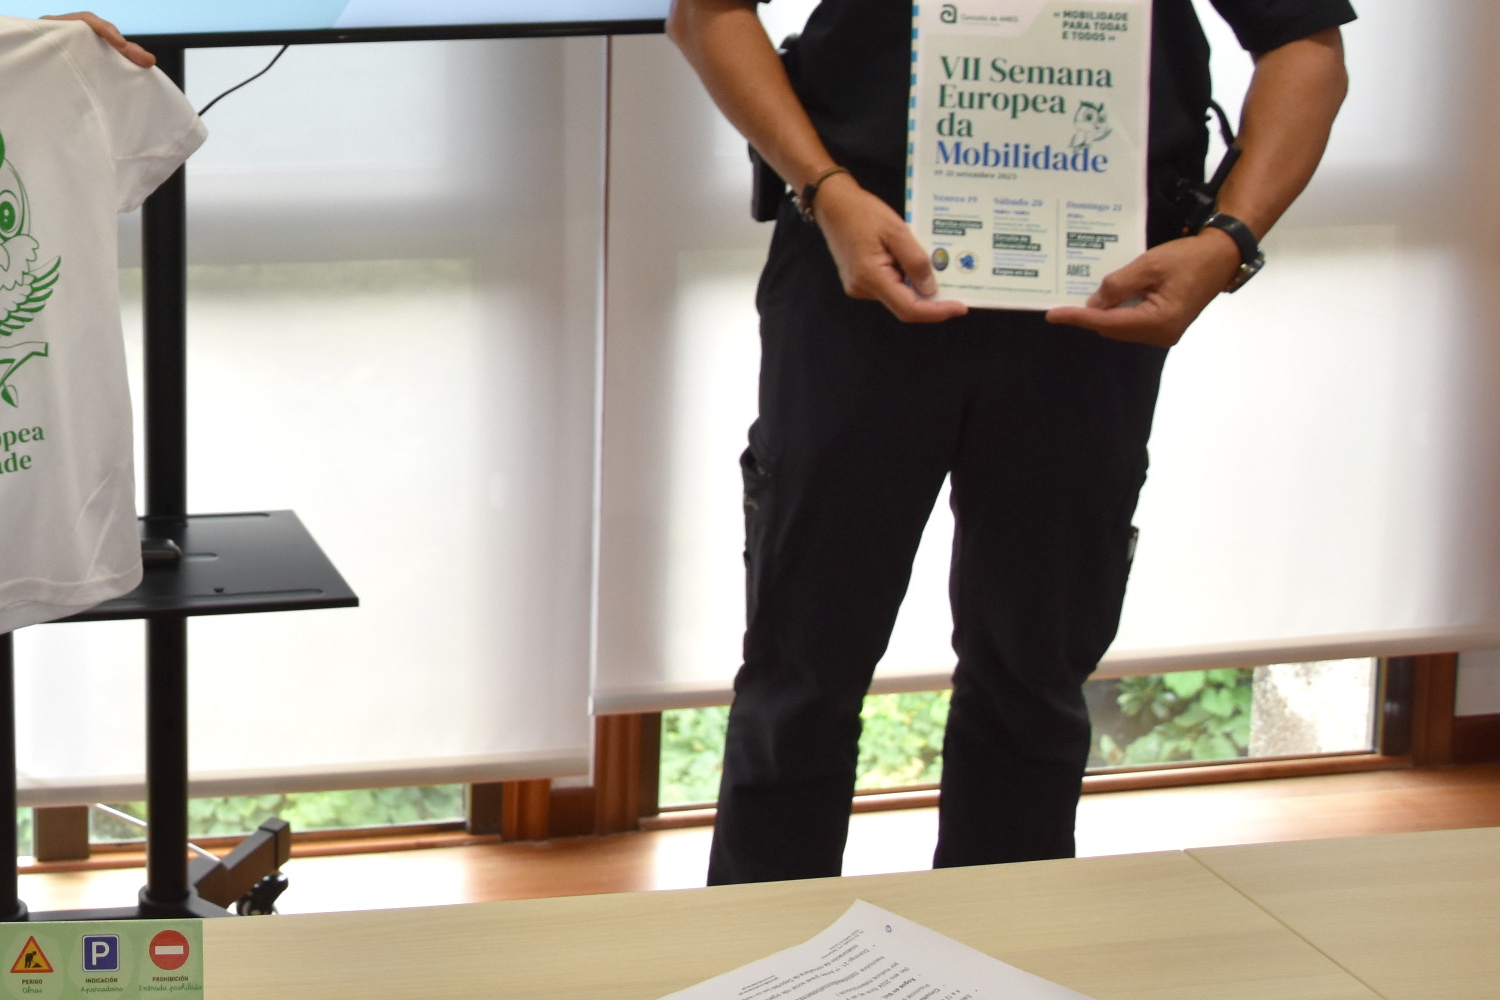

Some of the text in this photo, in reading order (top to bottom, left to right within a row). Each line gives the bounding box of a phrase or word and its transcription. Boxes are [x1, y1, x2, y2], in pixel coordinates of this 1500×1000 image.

[1062, 10, 1129, 21] MOBILIDADE
[1062, 20, 1129, 31] PARA TODAS
[1062, 31, 1106, 41] E TODOS
[938, 56, 1113, 88] VII Semana
[938, 83, 1067, 119] Europea
[936, 112, 974, 138] da
[935, 140, 1109, 174] Mobilidade
[91, 941, 110, 966] P
[152, 974, 189, 982] PROHIBICIÓN
[22, 985, 43, 994] Obras
[80, 984, 124, 993] Aparcadoiro
